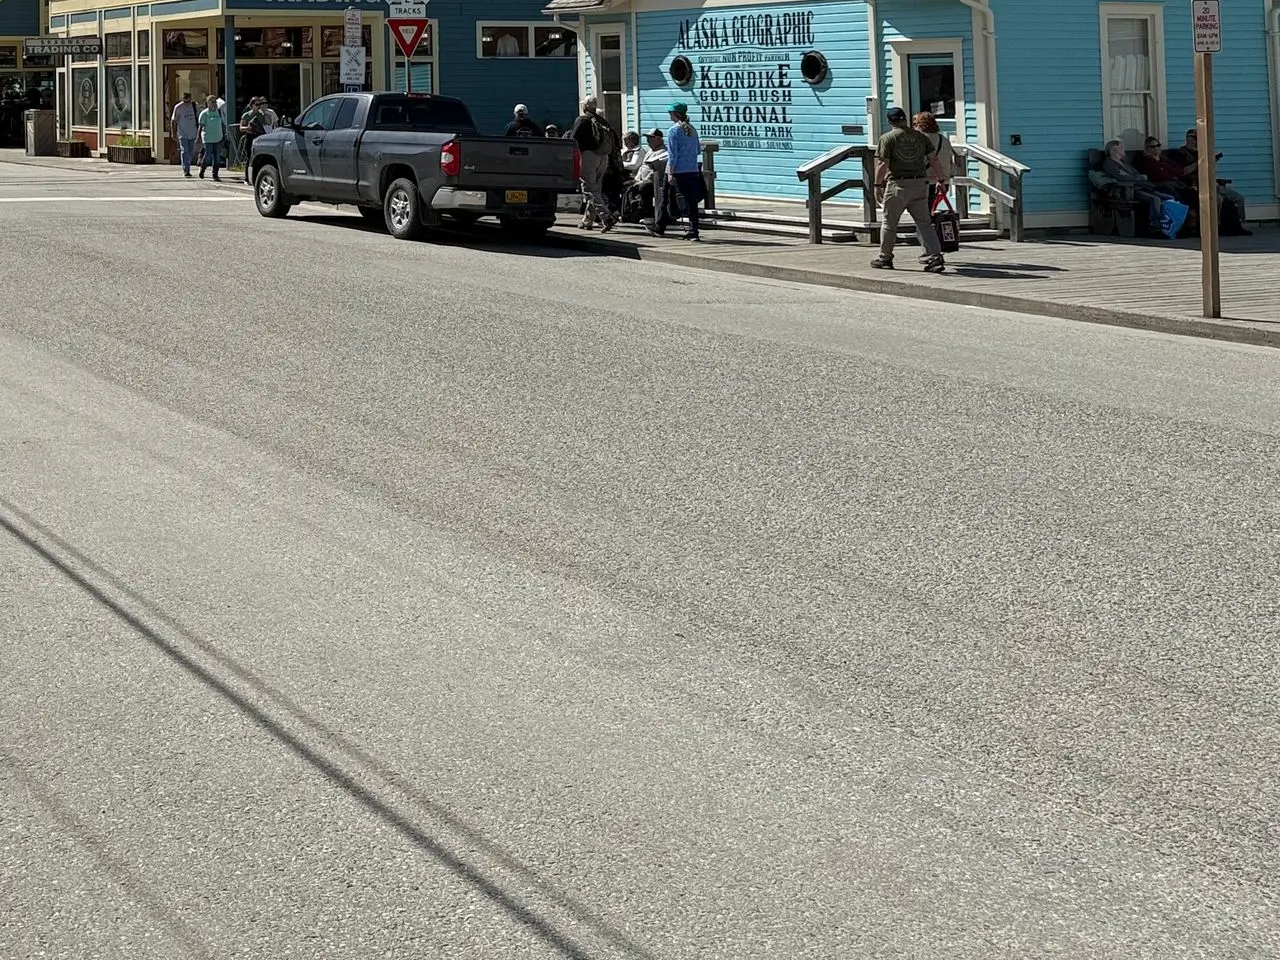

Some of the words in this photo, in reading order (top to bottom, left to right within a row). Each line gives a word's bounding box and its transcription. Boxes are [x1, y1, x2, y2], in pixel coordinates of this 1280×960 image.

[394, 7, 422, 15] TRACKS
[678, 17, 729, 50] ALASKA
[732, 10, 814, 47] GEOGRAPHIC
[700, 63, 792, 89] KLONDIKE
[700, 90, 739, 102] GOLD
[748, 90, 792, 102] RUSH
[701, 106, 793, 123] NATIONAL
[700, 125, 760, 137] HISTORICAL
[764, 127, 793, 138] PARK
